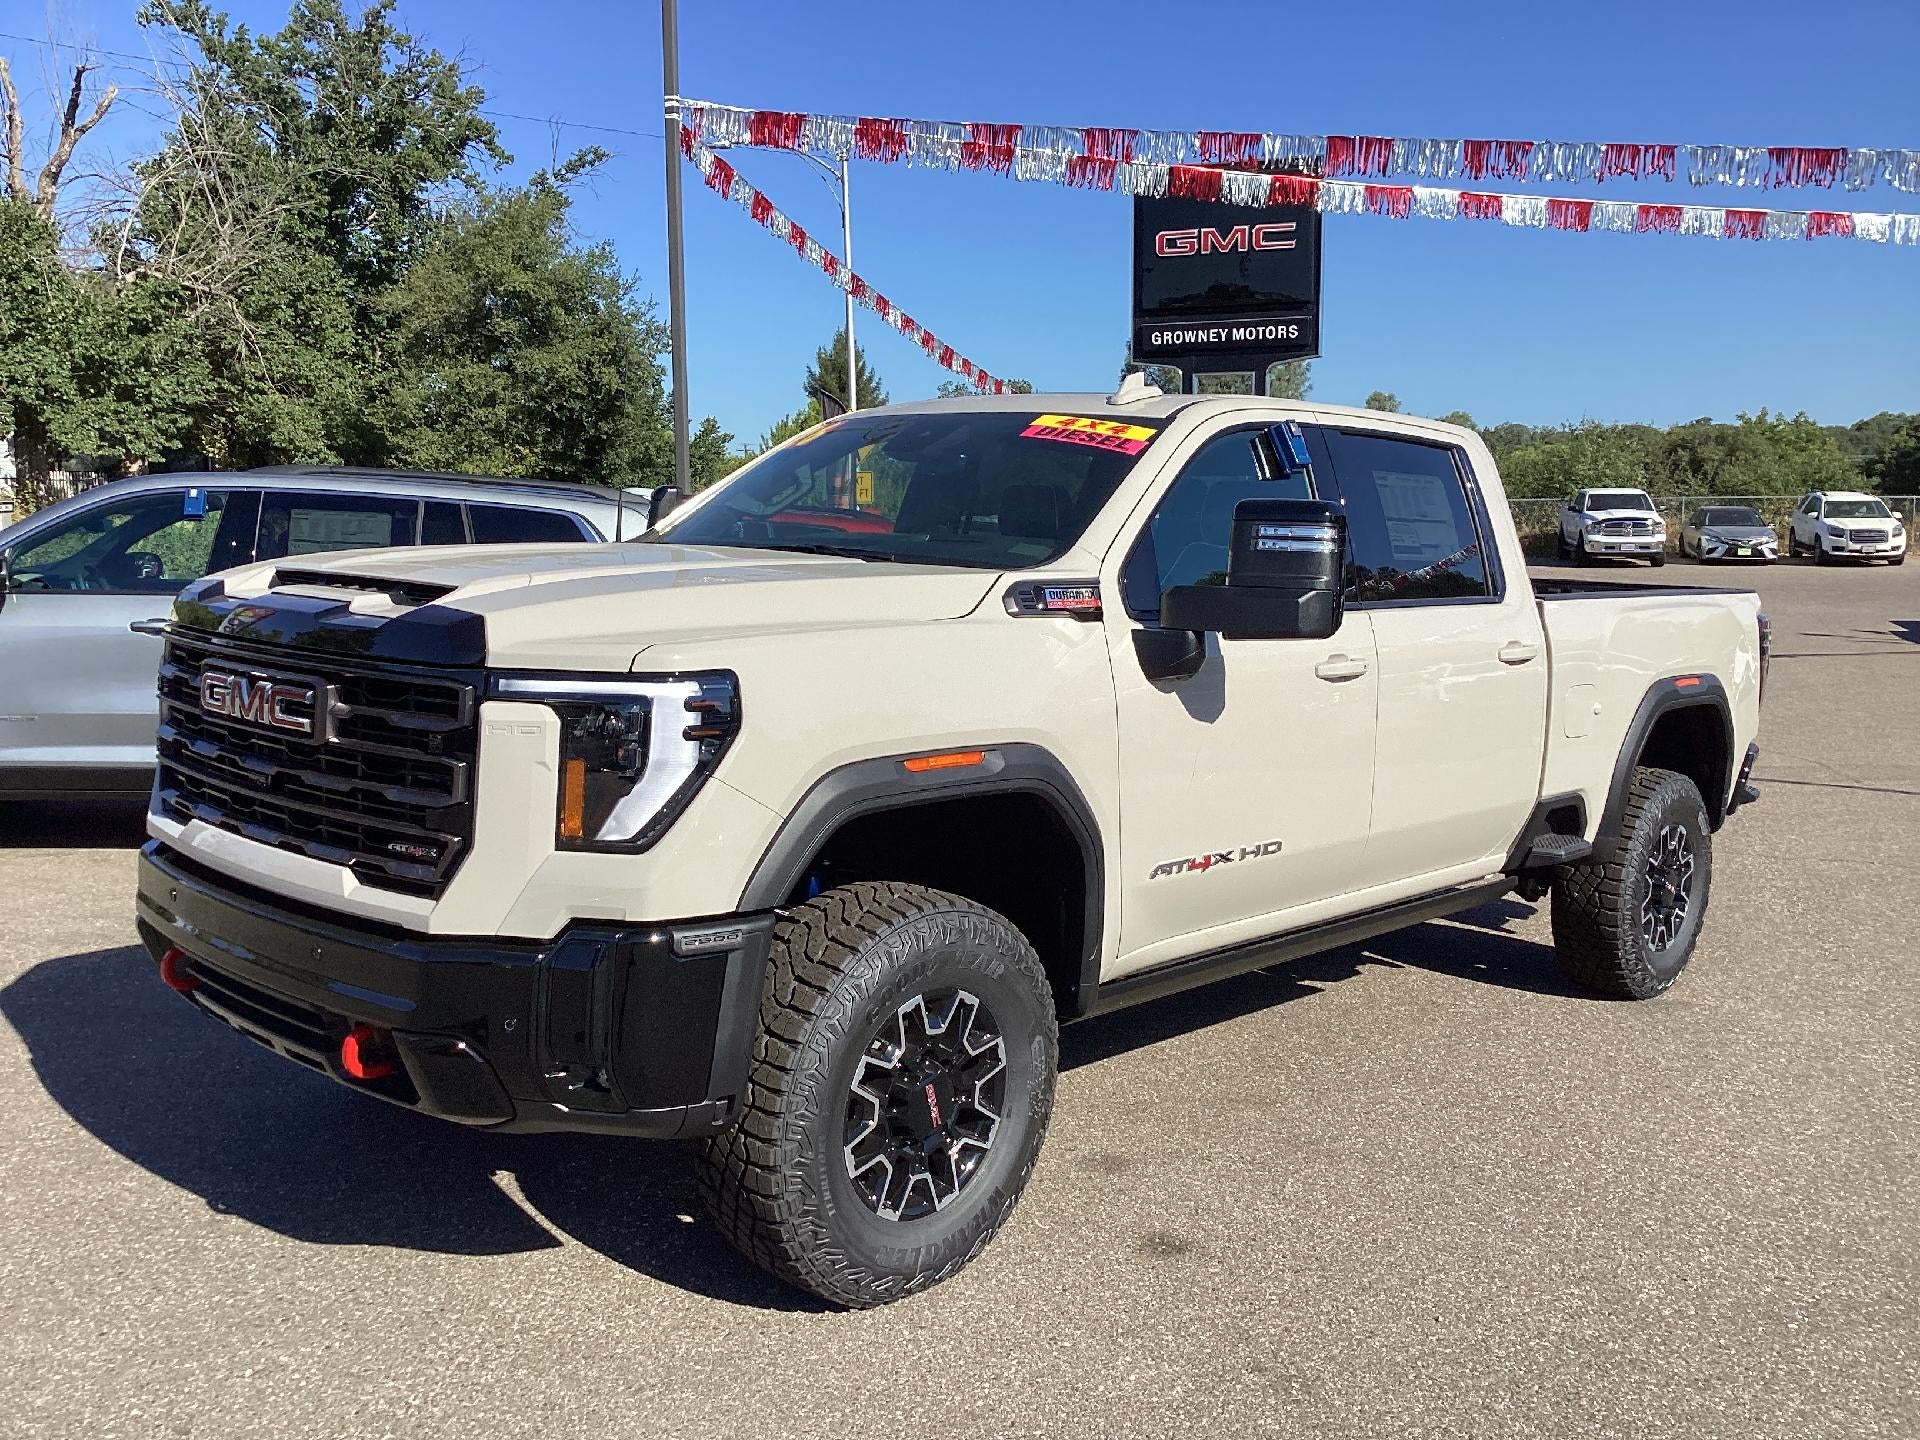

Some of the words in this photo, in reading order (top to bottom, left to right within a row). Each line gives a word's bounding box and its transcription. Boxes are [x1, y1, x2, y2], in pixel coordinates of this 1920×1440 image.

[1155, 222, 1297, 257] GMC
[1151, 328, 1229, 345] GROWNEY
[1232, 324, 1299, 341] MOTORS
[1033, 426, 1133, 451] DIESEL
[859, 488, 869, 499] FT
[1048, 590, 1095, 600] DURAMAX
[201, 671, 316, 733] GMC
[486, 724, 542, 737] HD
[1150, 850, 1234, 879] AT4X
[1239, 840, 1283, 861] HD
[866, 950, 1005, 1025] GOODEAR
